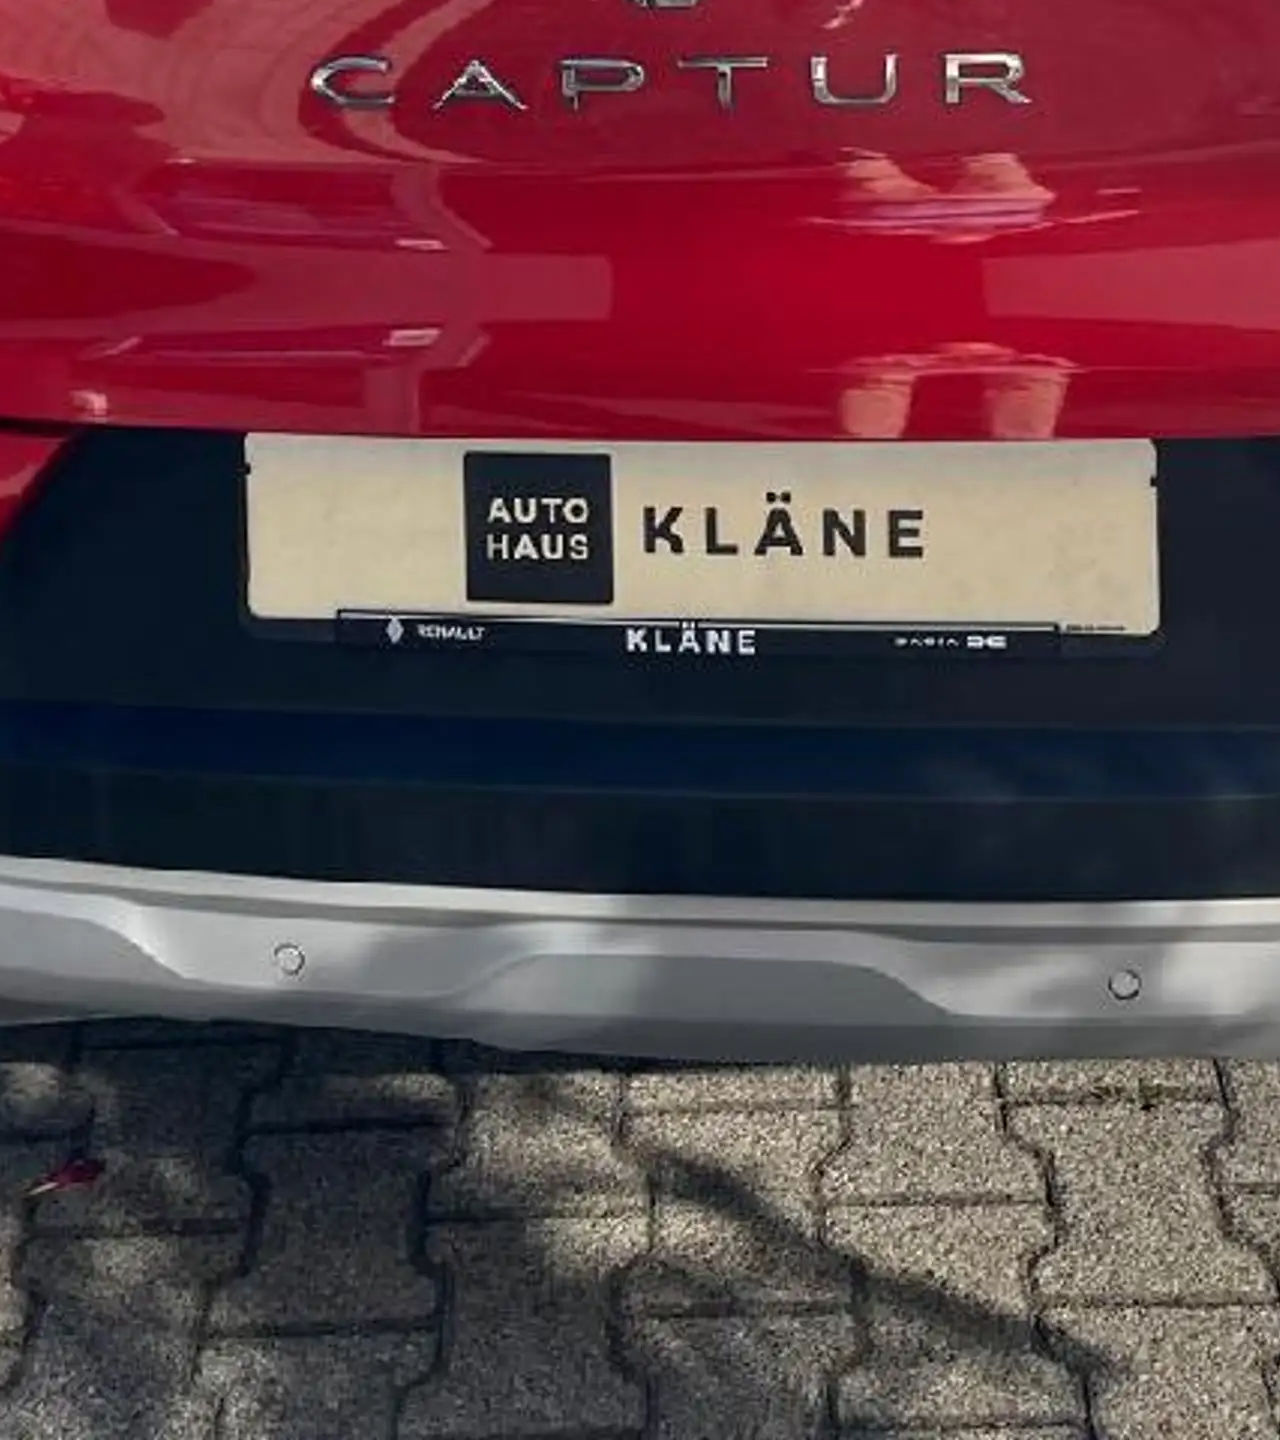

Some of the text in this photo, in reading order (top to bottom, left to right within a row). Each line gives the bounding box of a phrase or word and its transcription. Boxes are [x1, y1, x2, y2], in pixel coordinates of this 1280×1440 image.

[310, 55, 1031, 111] CAPTUR
[487, 498, 589, 524] AUTO
[643, 492, 924, 558] KLÄNE
[487, 534, 589, 560] HAUS
[626, 621, 756, 655] KLÄNE
